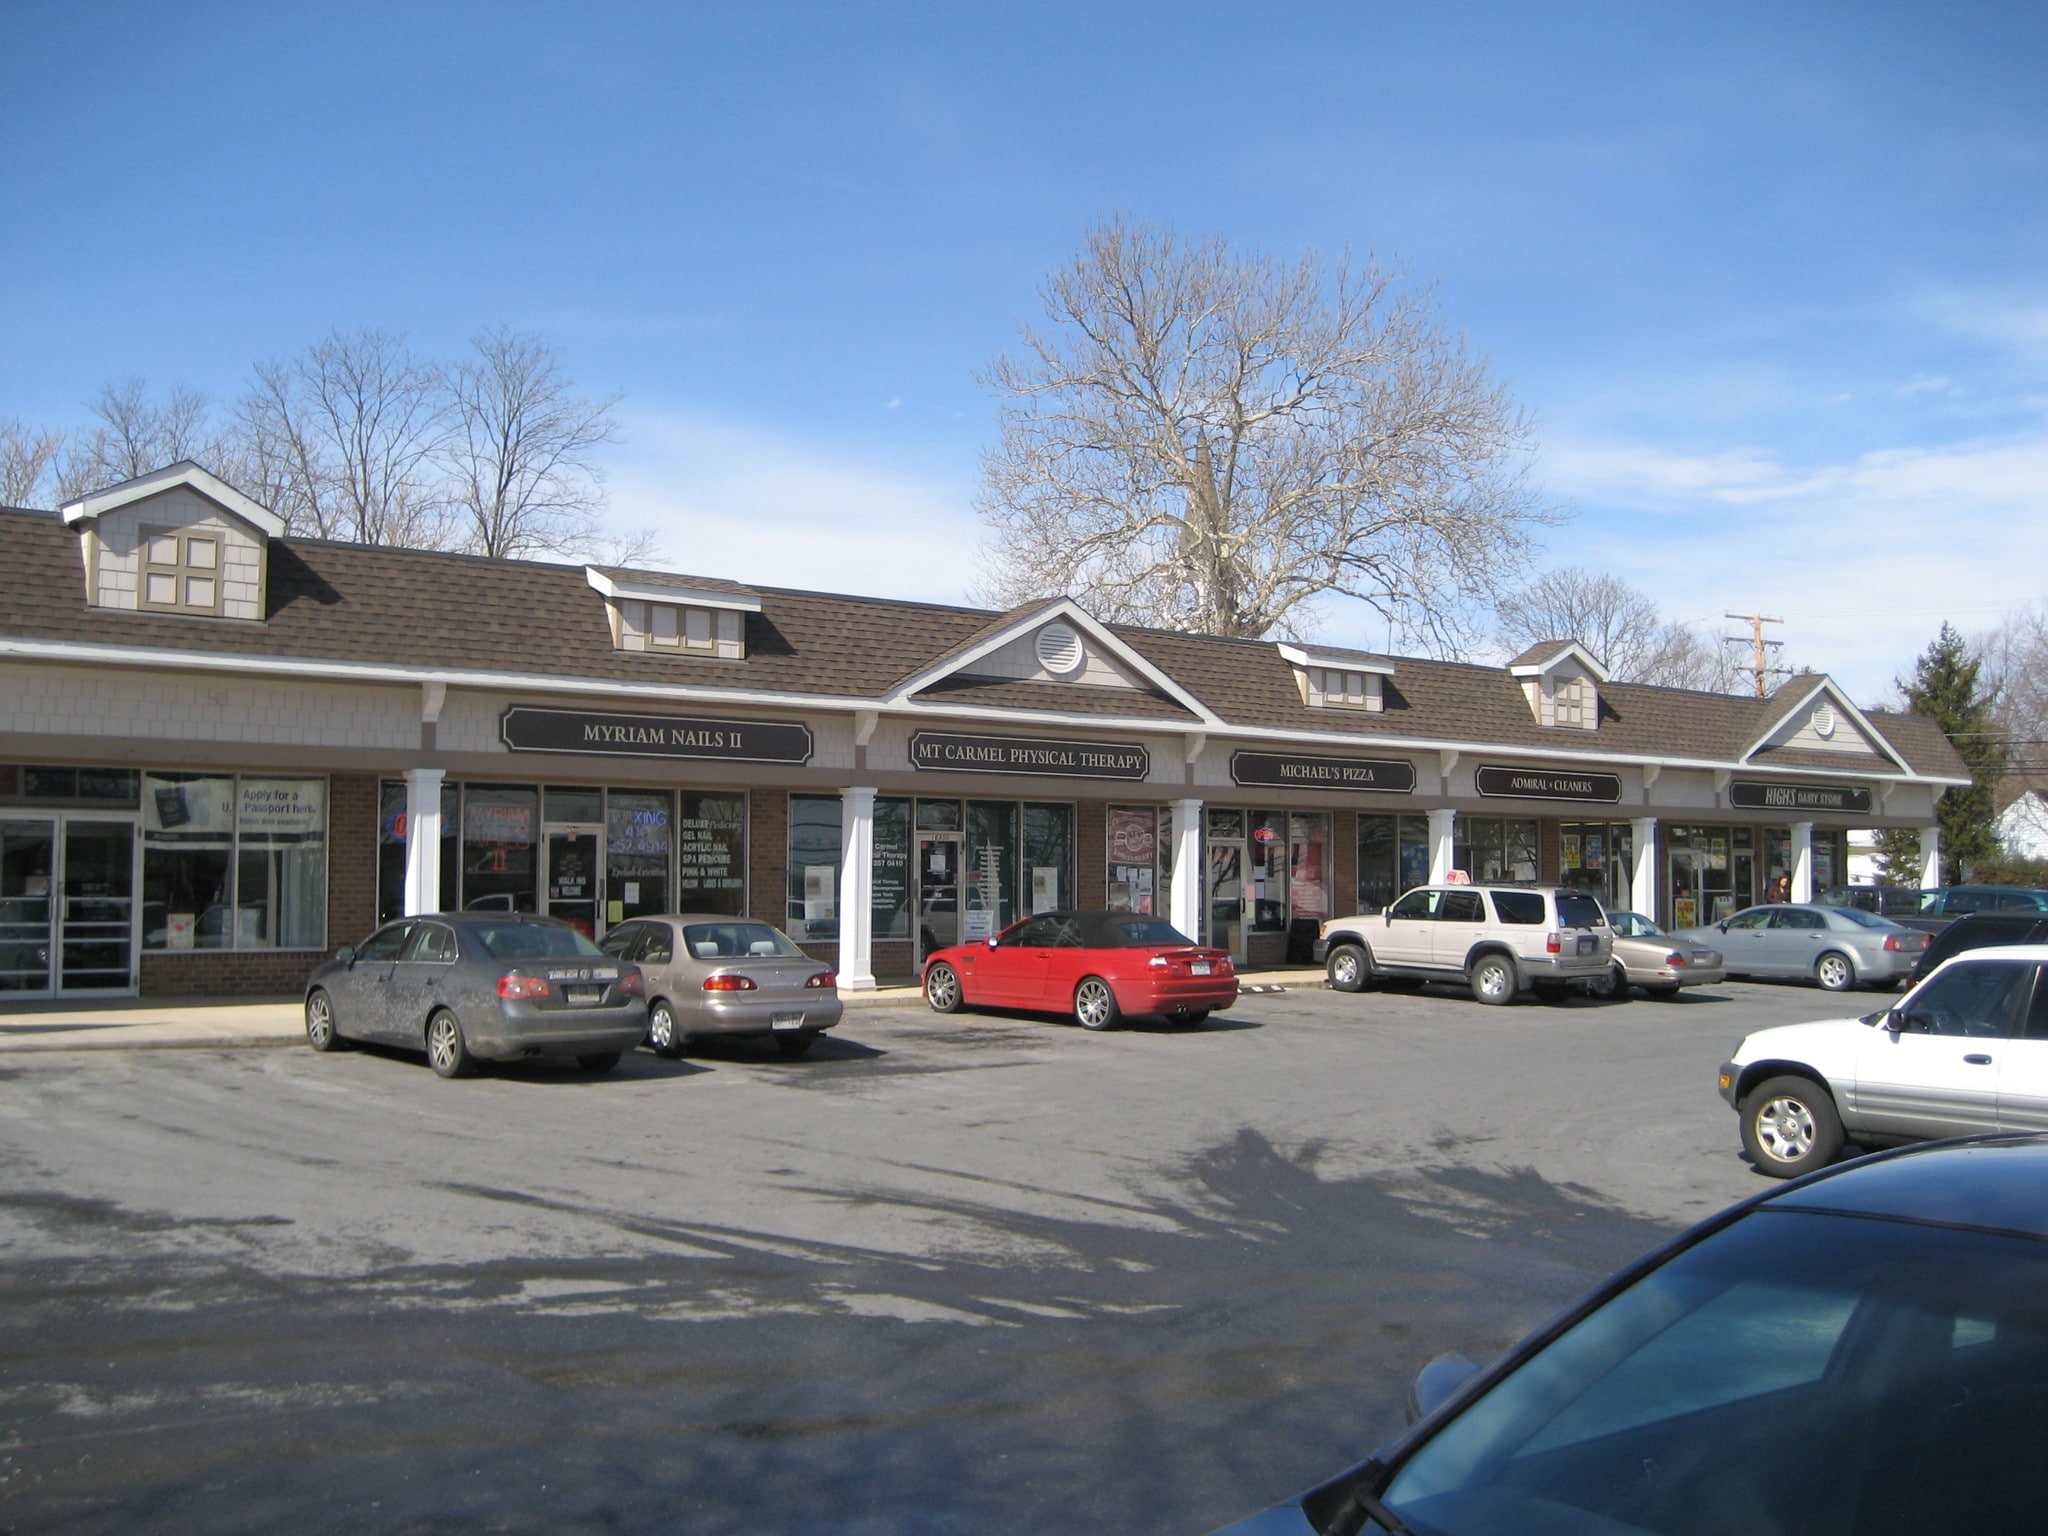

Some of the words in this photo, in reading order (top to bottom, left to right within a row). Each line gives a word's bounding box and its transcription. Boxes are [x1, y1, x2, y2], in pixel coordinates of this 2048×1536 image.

[583, 725, 665, 744] MYRIAM
[671, 730, 724, 747] NAILS
[729, 732, 743, 748] II
[919, 744, 942, 758] MT
[945, 745, 1006, 761] CARMEL
[1010, 749, 1076, 765] PHYSICAL
[1080, 753, 1142, 769] THERAPY
[1280, 764, 1341, 779] MICHAEL'S
[1343, 768, 1375, 781] PIZZA
[1511, 777, 1547, 790] ADMIRAL
[1554, 780, 1592, 792] CLEANERS
[243, 789, 271, 801] Apply
[275, 790, 289, 800] for
[244, 802, 290, 815] Passport
[683, 819, 709, 829] DELUXE
[683, 831, 696, 840] GEL
[697, 831, 712, 840] NAIL
[683, 843, 711, 852] ACRYLIC
[683, 855, 697, 863] SPA
[698, 855, 731, 864] PEDICURE
[883, 852, 908, 860] Therapy
[682, 867, 699, 876] PINK
[707, 868, 728, 876] WHITE
